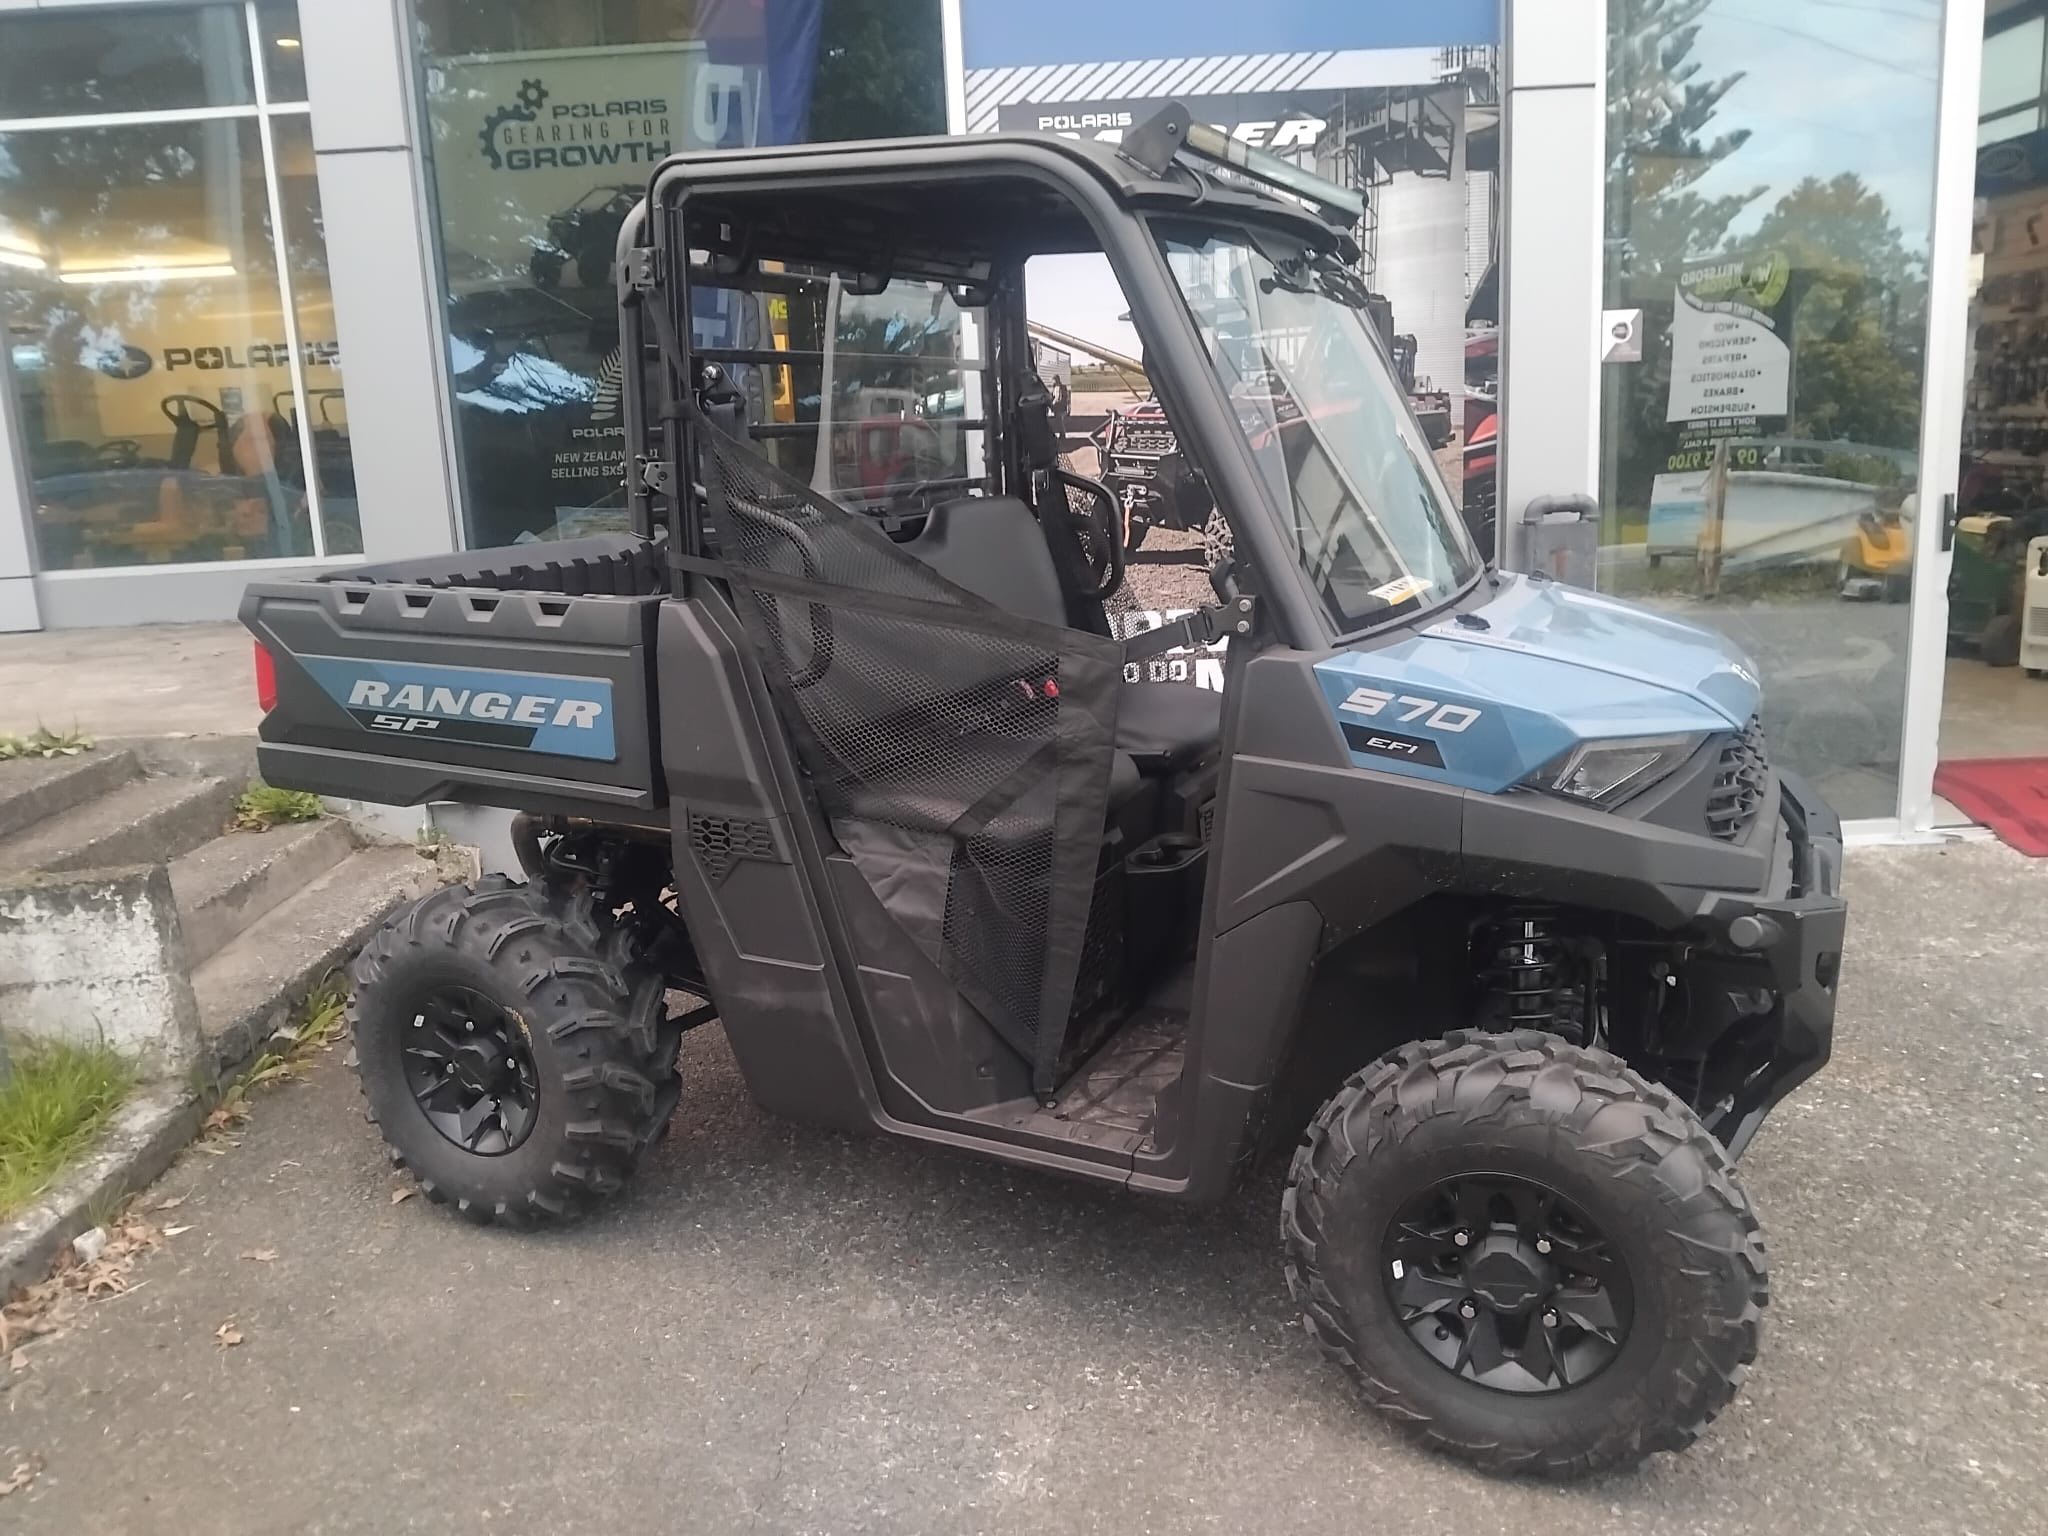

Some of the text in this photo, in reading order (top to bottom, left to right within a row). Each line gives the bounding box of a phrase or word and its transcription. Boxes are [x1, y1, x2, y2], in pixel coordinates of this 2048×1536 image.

[552, 99, 668, 120] POLARIS
[1038, 112, 1133, 131] POLARIS
[503, 118, 671, 145] GEARING FOR
[506, 140, 672, 171] GROWTH
[572, 427, 626, 439] POLAR
[555, 452, 580, 463] NEW
[583, 450, 626, 463] ZEALAN
[551, 466, 600, 479] SELLING
[348, 679, 602, 729] RANGER
[1338, 687, 1483, 734] 570
[370, 714, 441, 732] SP
[1365, 736, 1418, 754] EFI
